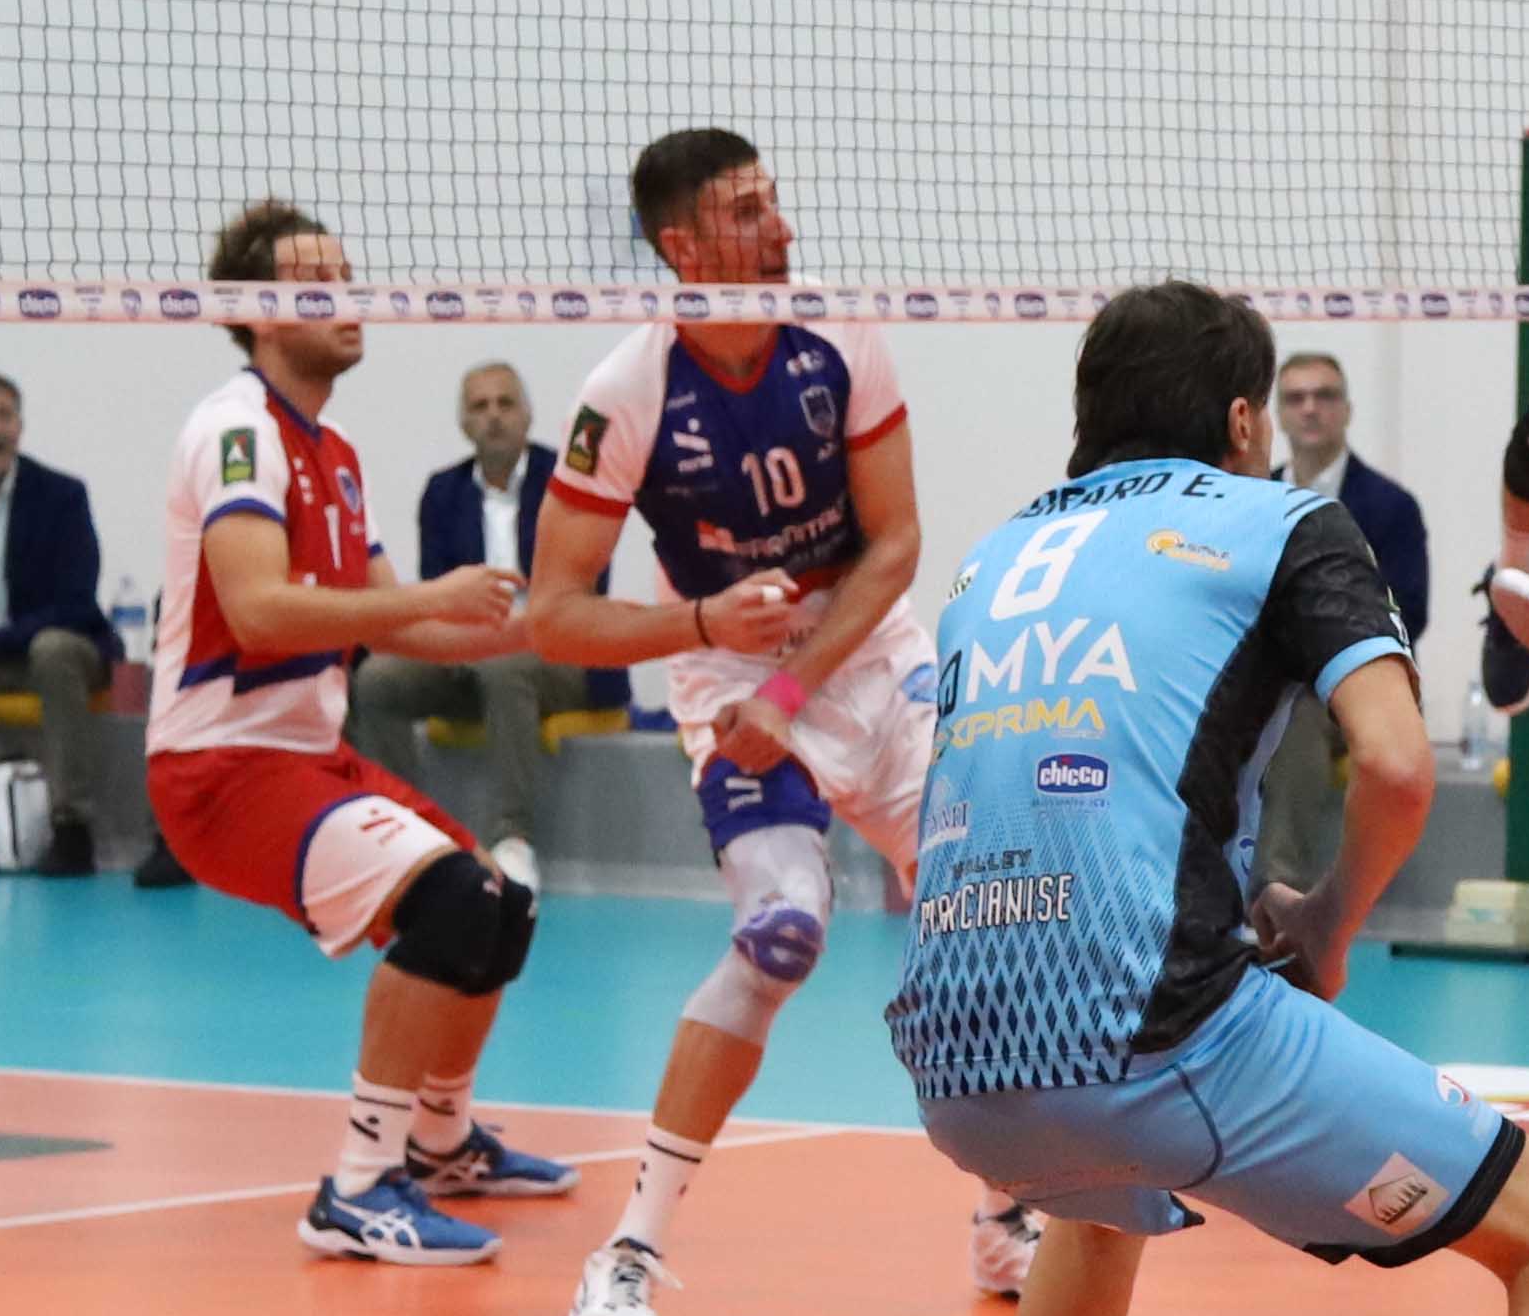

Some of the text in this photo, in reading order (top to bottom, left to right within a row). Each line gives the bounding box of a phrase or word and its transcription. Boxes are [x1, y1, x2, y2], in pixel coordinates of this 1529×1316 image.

[741, 446, 806, 517] 10
[1181, 472, 1225, 499] E.
[989, 508, 1109, 622] 8
[966, 618, 1138, 703] MYA
[1040, 760, 1105, 786] chicco
